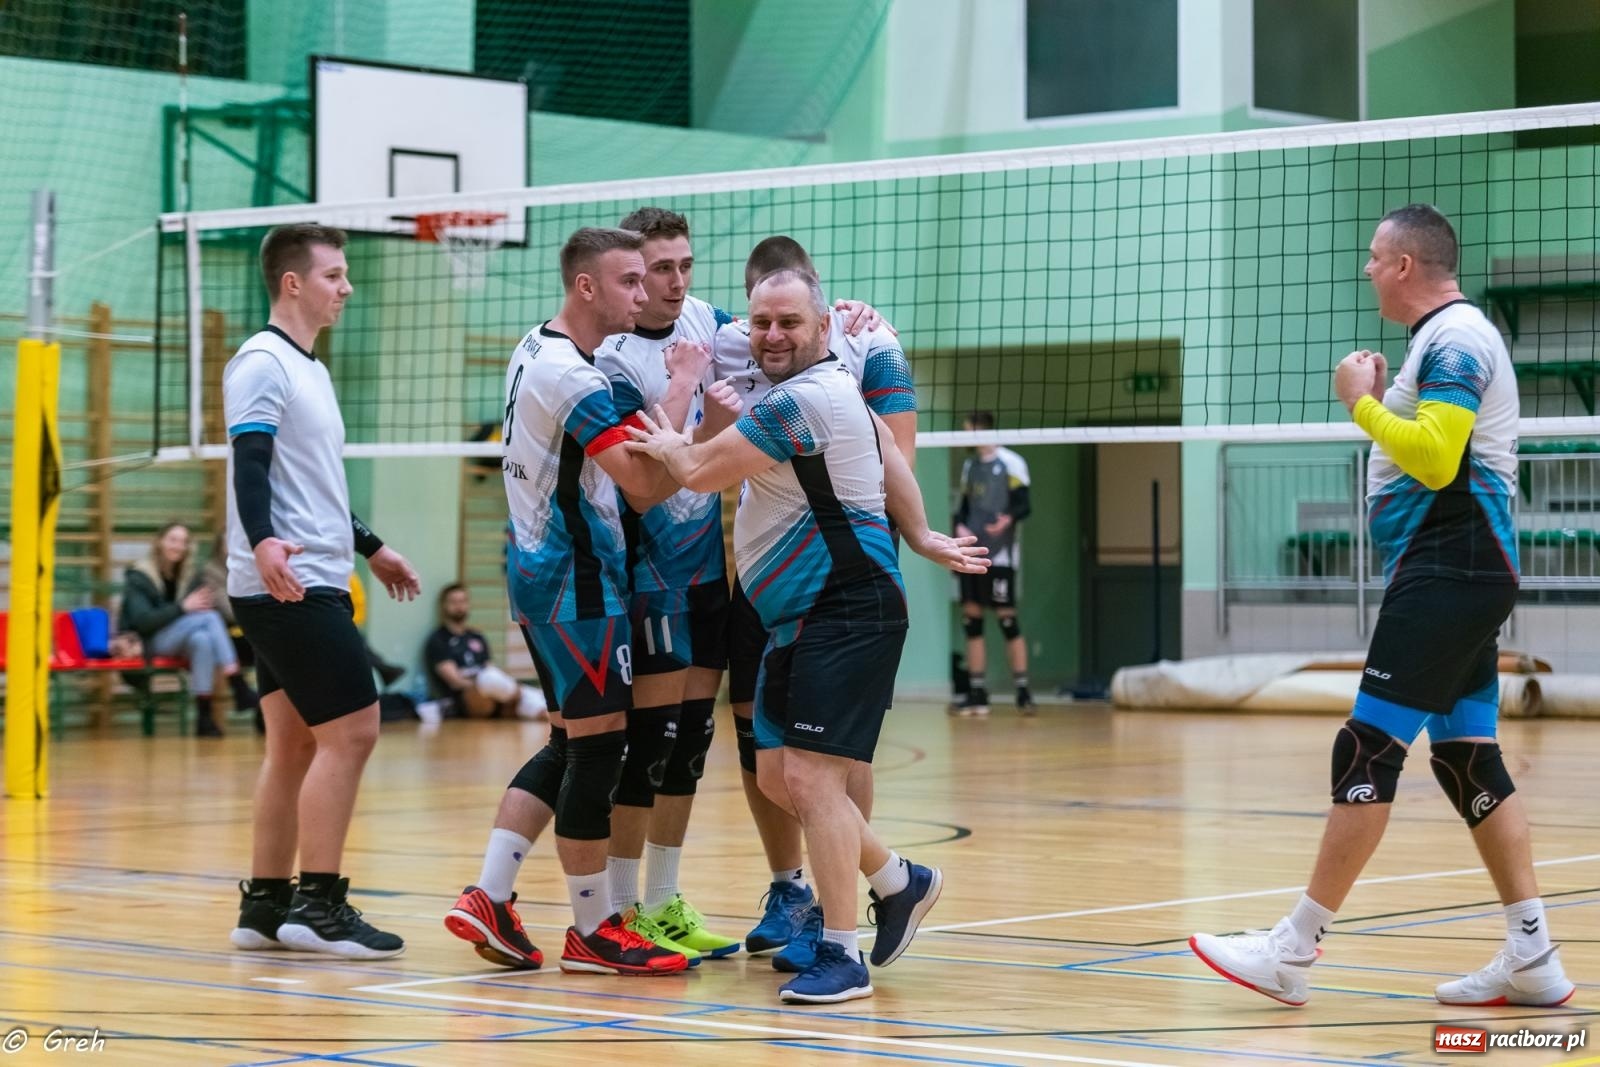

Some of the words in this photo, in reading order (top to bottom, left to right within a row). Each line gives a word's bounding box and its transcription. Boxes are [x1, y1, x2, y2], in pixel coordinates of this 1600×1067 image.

[644, 615, 673, 656] 11
[616, 644, 632, 686] 8
[1364, 667, 1392, 680] COLO
[794, 722, 825, 733] COLO
